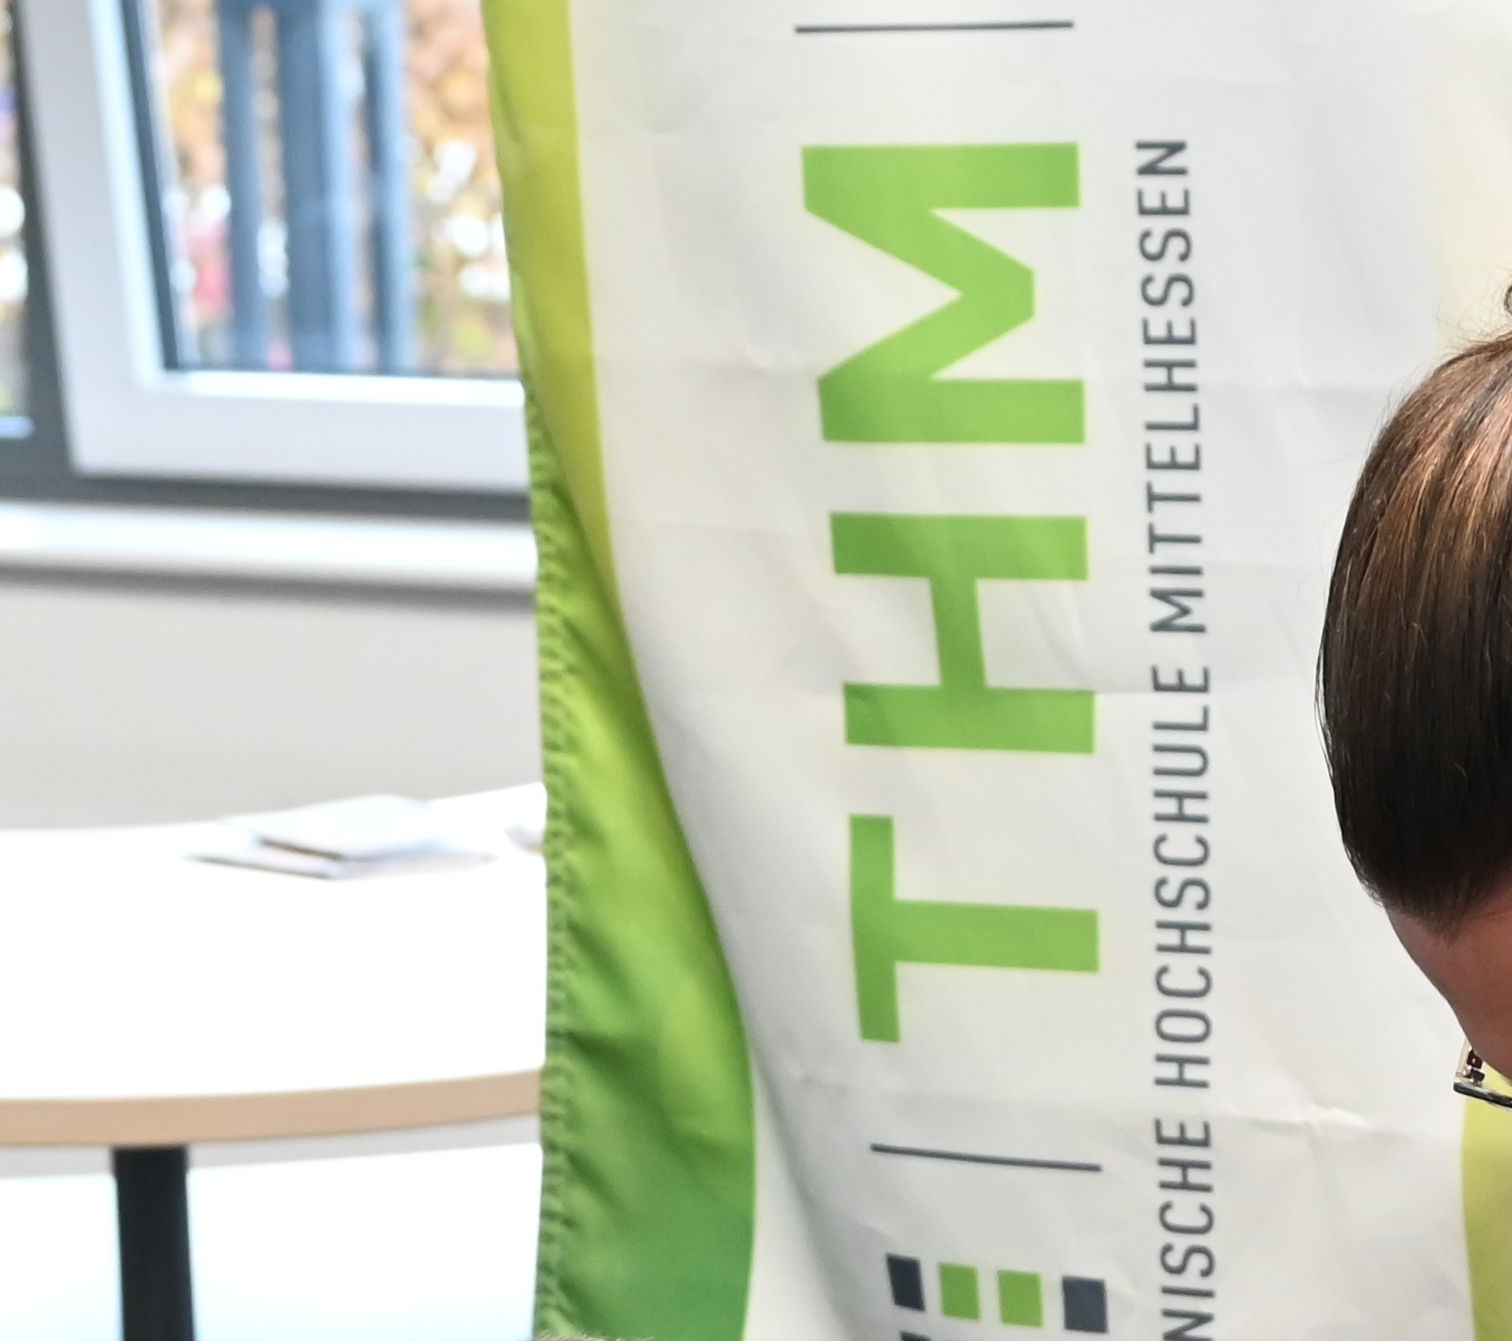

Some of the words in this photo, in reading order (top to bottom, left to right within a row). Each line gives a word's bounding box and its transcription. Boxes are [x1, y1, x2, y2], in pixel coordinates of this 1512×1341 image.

[801, 142, 1100, 1043] THM
[1134, 140, 1208, 634] MITTELHESSEN
[1151, 665, 1213, 1090] HOCHSCHULE
